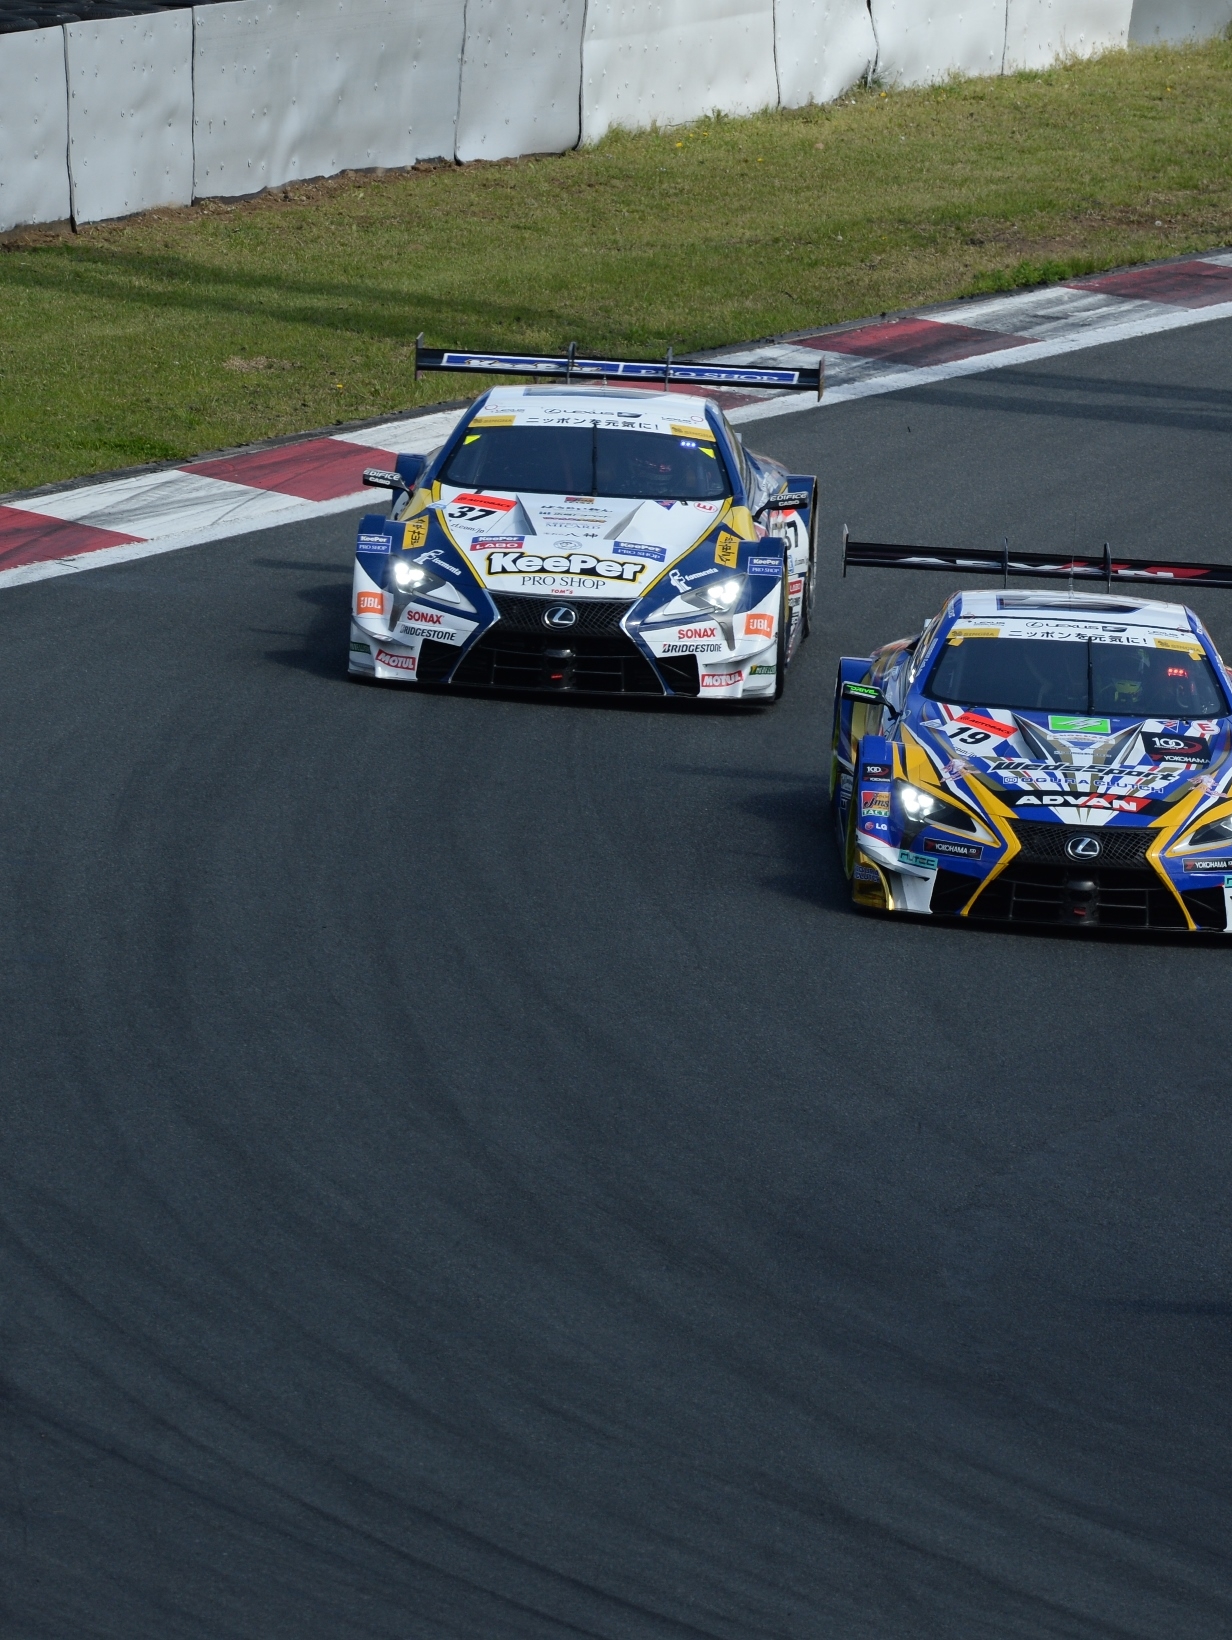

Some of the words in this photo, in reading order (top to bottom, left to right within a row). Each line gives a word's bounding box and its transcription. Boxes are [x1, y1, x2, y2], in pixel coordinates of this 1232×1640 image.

[526, 416, 660, 431] ニッポンを元気に!
[770, 492, 807, 502] EDIFICE
[448, 505, 498, 522] 37
[360, 535, 388, 544] KeePer
[474, 541, 519, 550] LABO
[619, 541, 663, 552] KeePer
[485, 551, 647, 582] KeePer
[753, 558, 780, 567] KeePer
[521, 575, 556, 587] PRO
[559, 576, 607, 591] SHOP
[360, 596, 382, 609] JBL
[406, 610, 443, 625] SONAX
[400, 624, 457, 641] BRIDGESTONE
[749, 619, 771, 632] JBL
[677, 627, 717, 640] SONAX
[1009, 629, 1149, 645] ニッポンを元気に!
[661, 643, 722, 654] BRIDGESTONE
[377, 652, 415, 669] MOTUL
[702, 672, 743, 687] MOTUL
[968, 718, 1012, 736] AUTOBACS
[949, 726, 992, 745] 19
[1151, 737, 1185, 750] 100
[1163, 755, 1212, 764] YOKOHAMA
[987, 760, 1180, 783] WedsSport
[1020, 776, 1090, 786] OGURA
[1093, 780, 1165, 795] CLUTCH
[1014, 794, 1139, 812] ADVAN
[875, 822, 888, 831] LG
[934, 842, 969, 855] YOKOHAMA
[1194, 860, 1228, 869] YOKOHAMA
